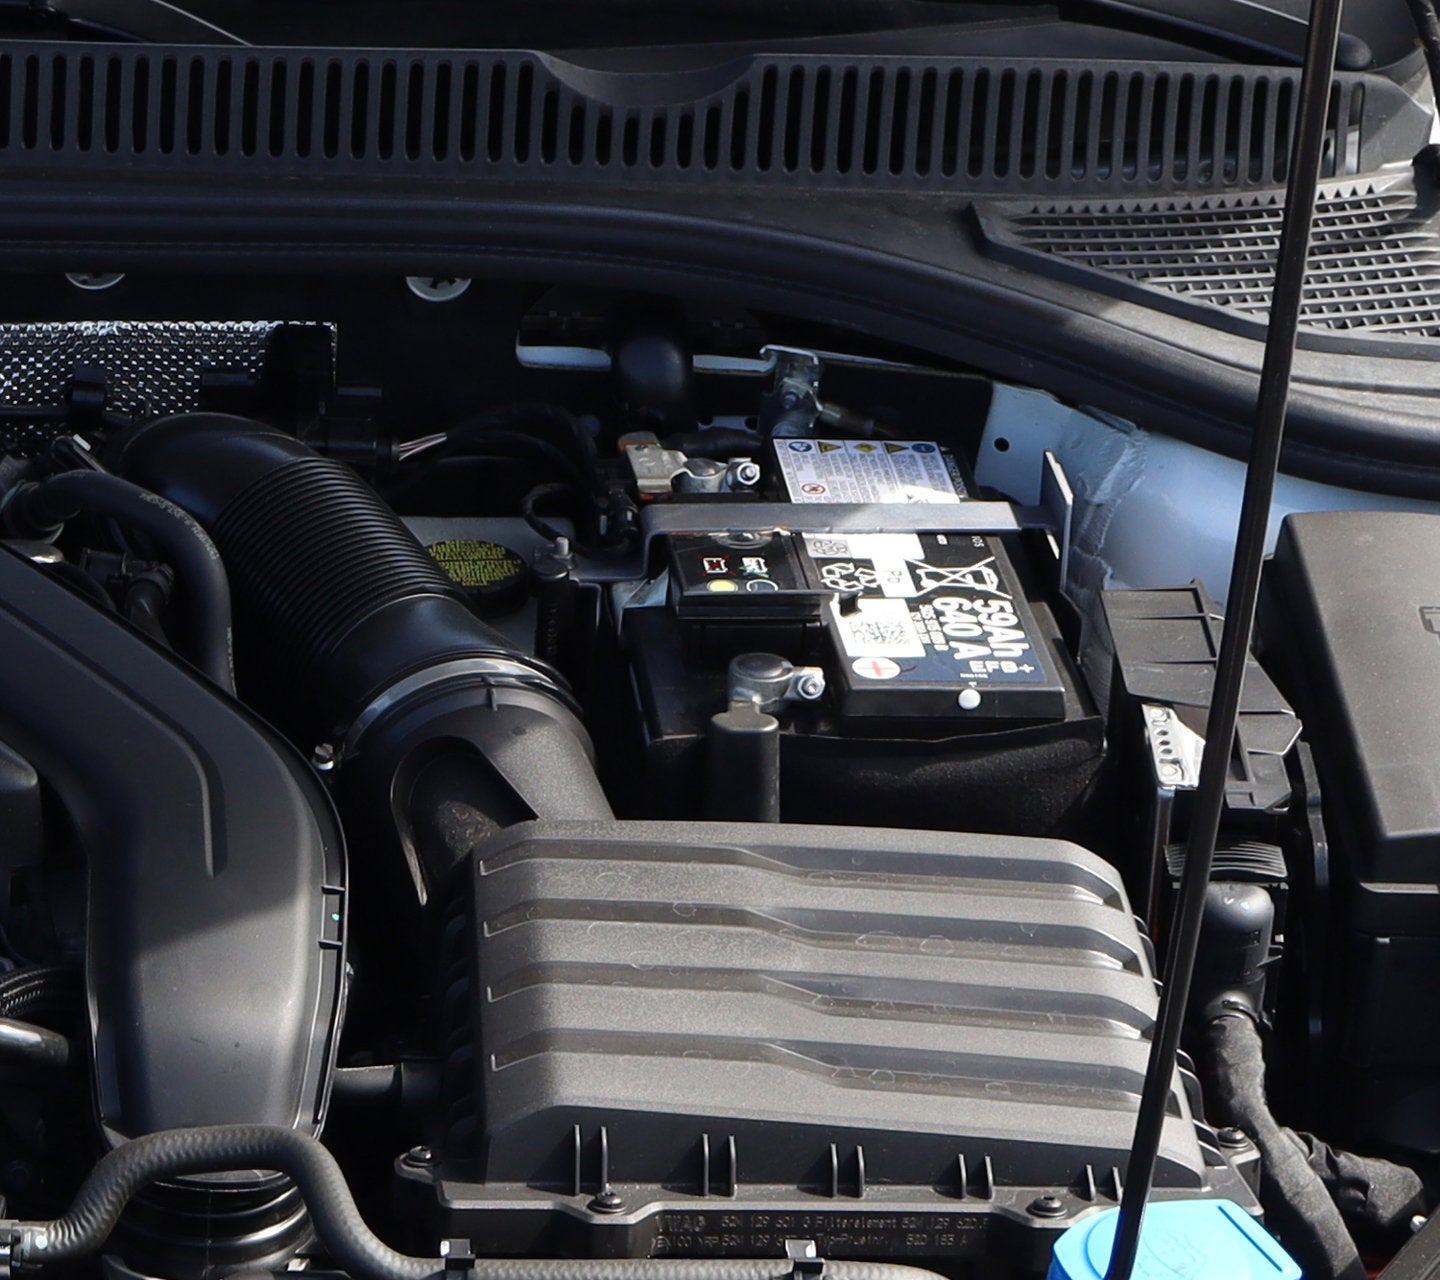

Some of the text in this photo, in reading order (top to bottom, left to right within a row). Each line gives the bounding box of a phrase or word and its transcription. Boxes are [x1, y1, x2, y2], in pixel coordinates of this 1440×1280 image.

[932, 596, 984, 637] 640
[972, 599, 1030, 657] 59Ah
[948, 640, 992, 660] A
[969, 659, 1035, 674] EFB+
